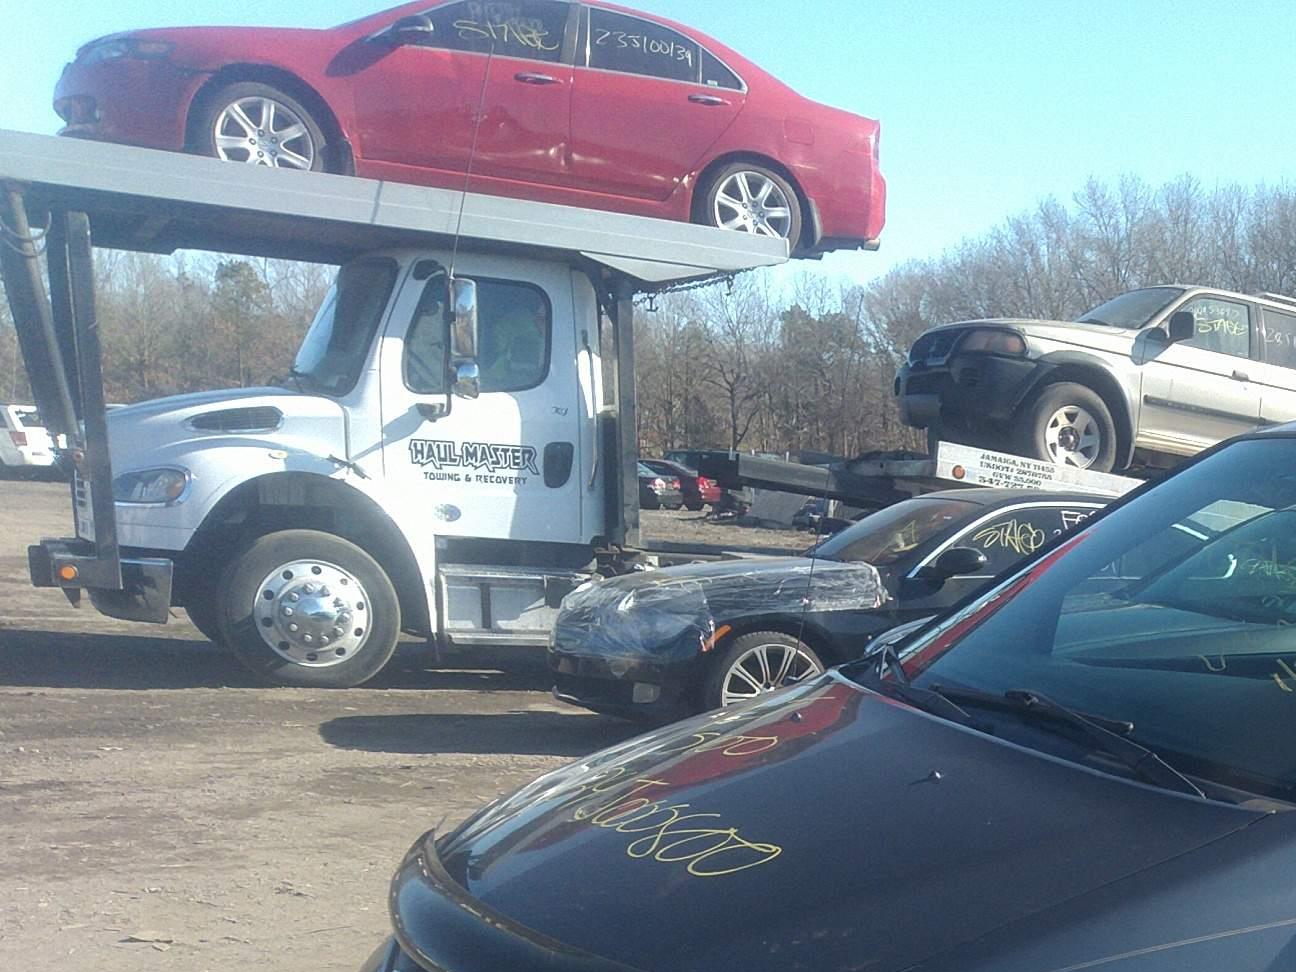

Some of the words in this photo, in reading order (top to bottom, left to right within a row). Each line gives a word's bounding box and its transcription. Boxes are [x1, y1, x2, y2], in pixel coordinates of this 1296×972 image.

[408, 439, 461, 469] HAUL
[461, 441, 539, 475] MASTER
[424, 472, 461, 482] TOWING
[464, 474, 472, 482] &
[475, 475, 527, 485] RECOVERY
